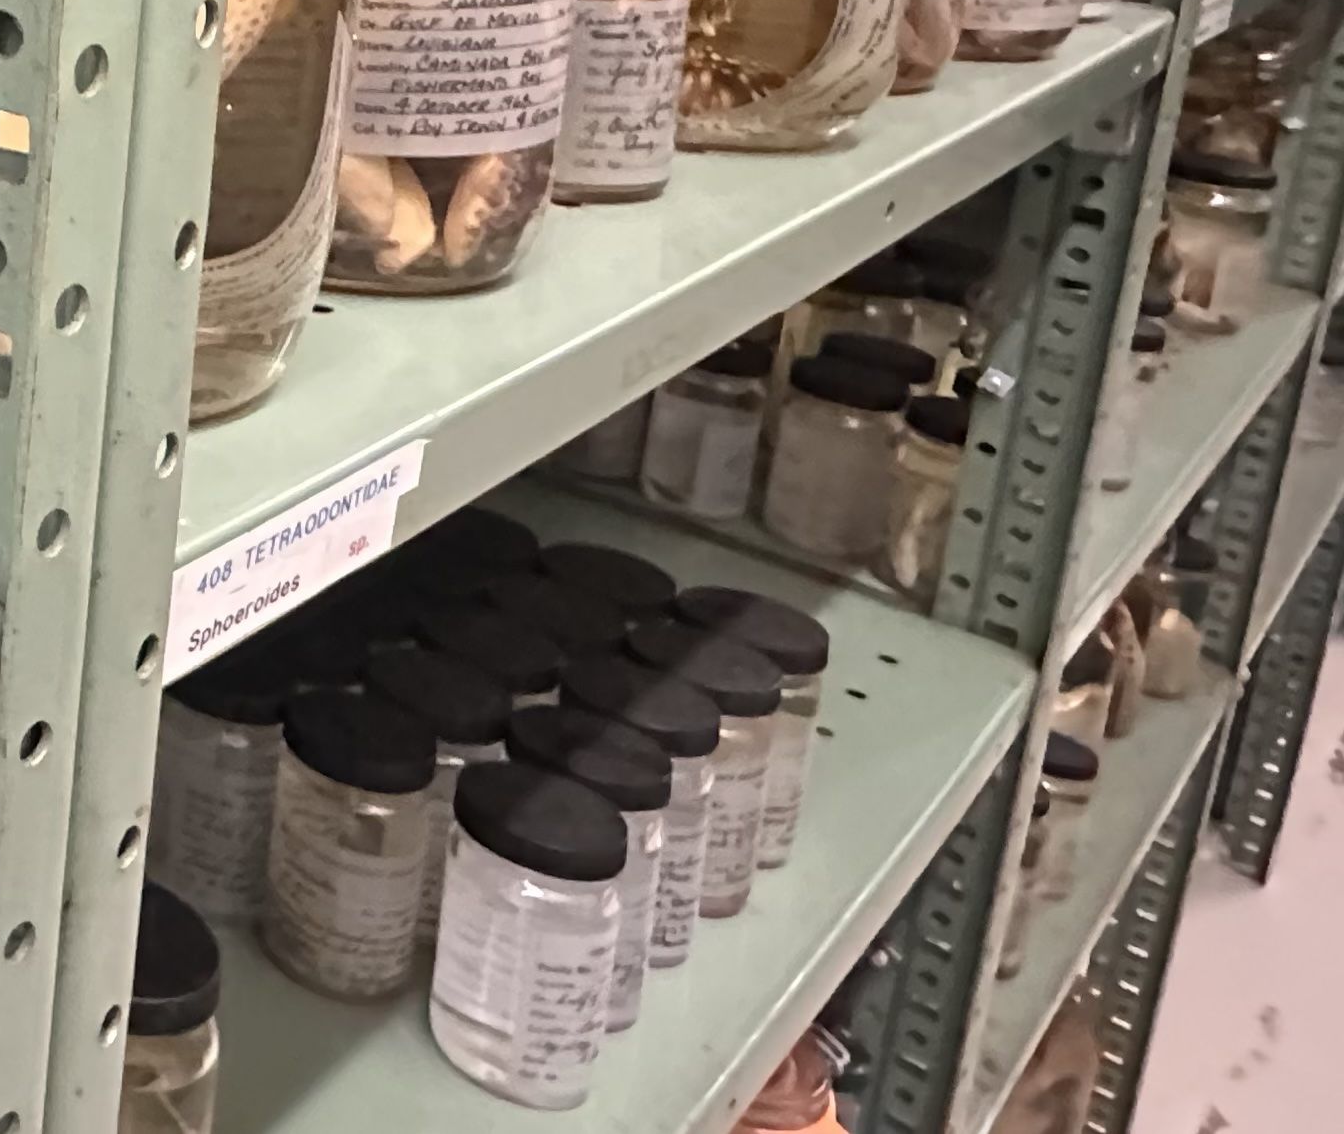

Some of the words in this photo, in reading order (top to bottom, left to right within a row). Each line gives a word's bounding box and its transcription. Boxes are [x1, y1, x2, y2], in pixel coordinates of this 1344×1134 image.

[196, 558, 233, 595] 408
[244, 464, 402, 571] TETRAODONTIDAE
[347, 533, 371, 558] sp.
[187, 573, 302, 654] Sphoeroides
